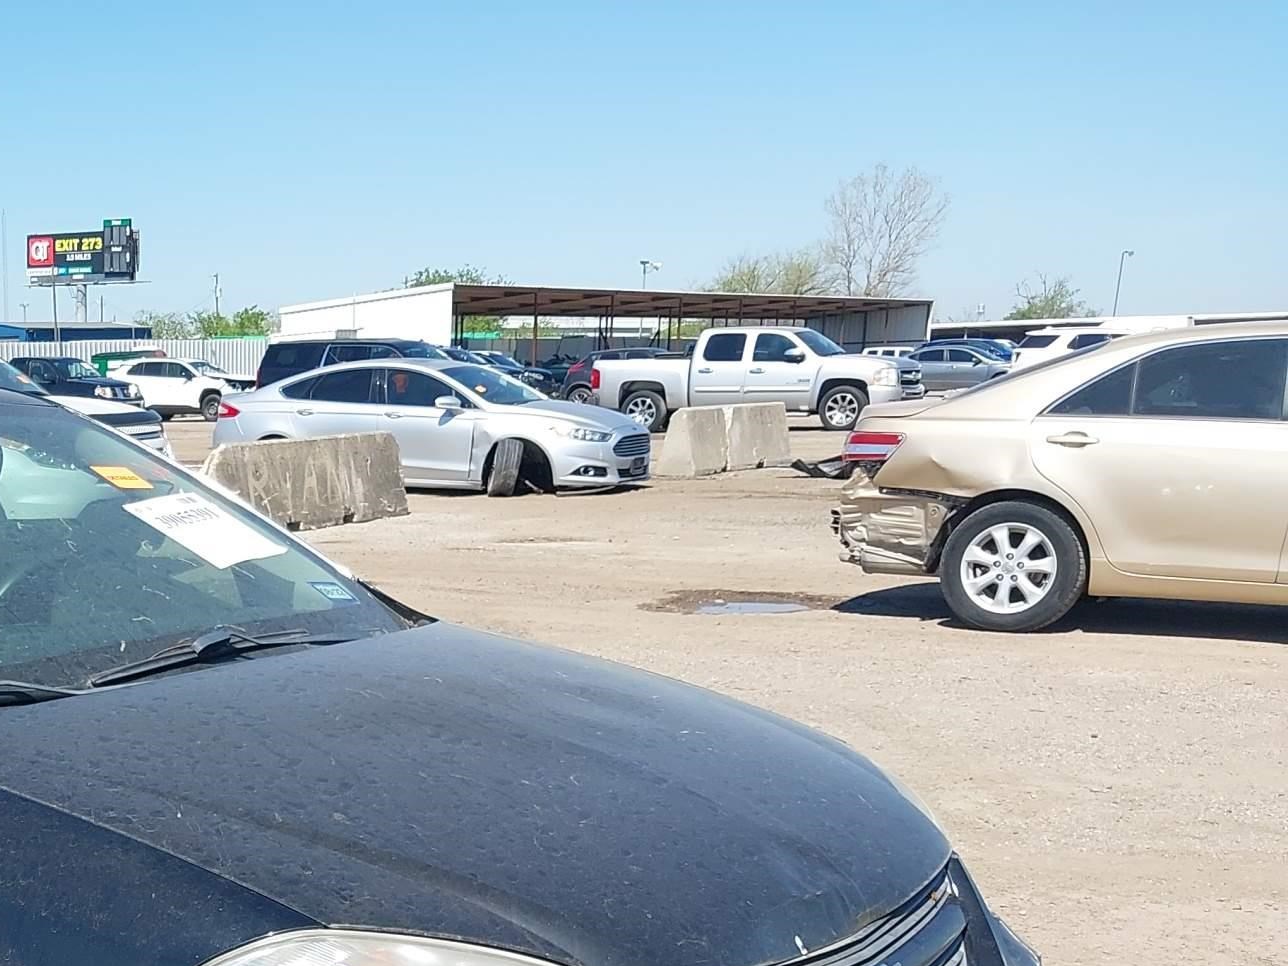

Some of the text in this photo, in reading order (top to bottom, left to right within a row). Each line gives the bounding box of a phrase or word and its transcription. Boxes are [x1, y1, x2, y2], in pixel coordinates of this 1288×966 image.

[30, 240, 50, 262] QT
[55, 239, 79, 252] EXIT
[81, 237, 102, 250] 273
[154, 507, 220, 529] 39055391
